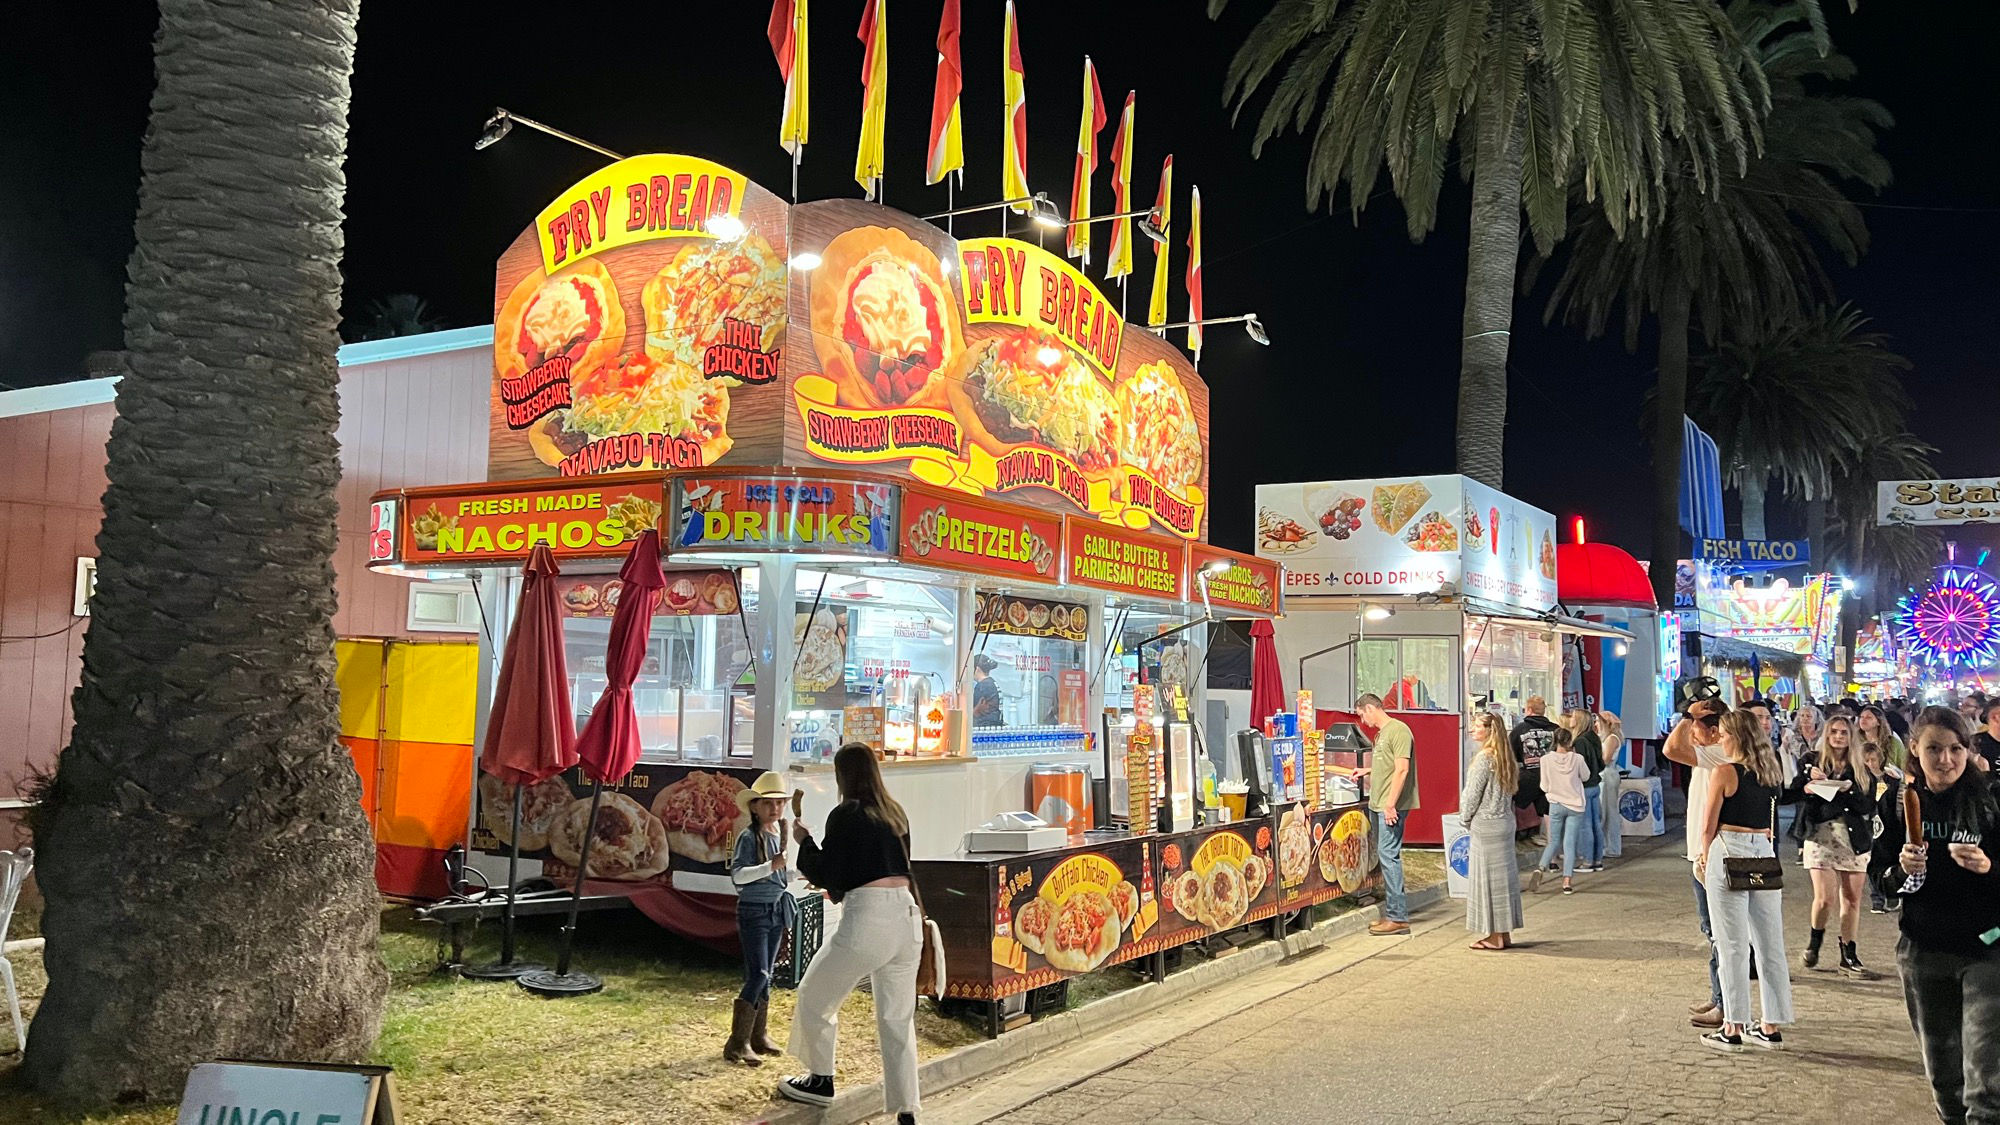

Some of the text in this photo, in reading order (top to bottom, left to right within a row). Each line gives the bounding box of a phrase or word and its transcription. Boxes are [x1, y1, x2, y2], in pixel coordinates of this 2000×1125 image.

[549, 174, 732, 265] FRY BREAD
[963, 247, 1120, 371] FRY BREAD
[723, 319, 762, 349] THAI
[501, 356, 571, 402] STRAWBERRY
[704, 347, 781, 383] CHICKEN
[507, 383, 572, 429] CHEESECAKE
[808, 410, 958, 455] STRAWBERRY CHEESECAKE
[560, 433, 702, 477] NAVAJO TACO
[746, 485, 835, 504] ICE COLD
[997, 452, 1089, 509] NAVAJO TACO
[459, 494, 601, 516] FRESH MADE
[1129, 476, 1195, 533] THAI CHICKEN
[437, 520, 625, 554] NACHOS
[704, 512, 871, 544] DRINKS
[937, 515, 1030, 562] PRETZELS
[1084, 534, 1169, 569] GARLIC BUTTER &
[1703, 539, 1796, 560] FISH TACO
[1075, 559, 1175, 593] PARMESAN CHEESE
[1208, 581, 1228, 590] FRESH
[1286, 571, 1445, 585] ÊPES COLD DRINKS
[1466, 572, 1483, 588] SWEET
[1210, 590, 1228, 599] MADE
[1229, 584, 1260, 606] NACHOS
[1674, 592, 1694, 607] DA
[1281, 742, 1294, 755] COLD
[629, 769, 649, 788] Taco
[1052, 861, 1079, 899] Buffalo
[1082, 858, 1109, 888] Chicken
